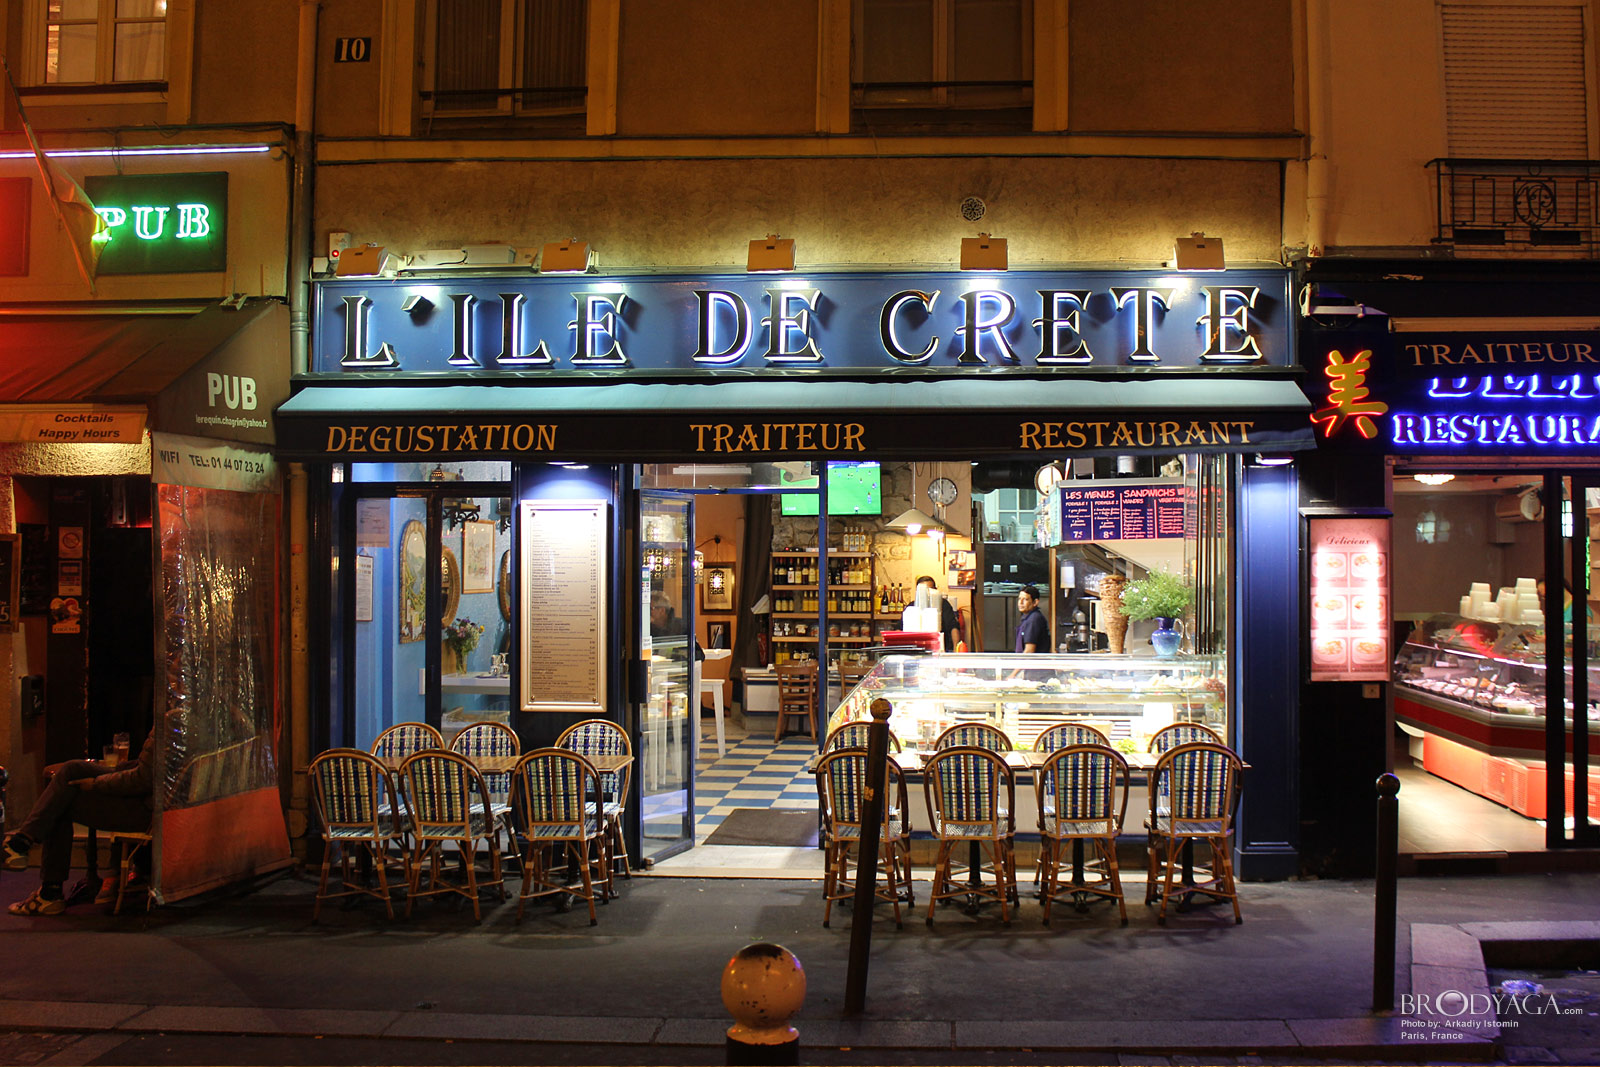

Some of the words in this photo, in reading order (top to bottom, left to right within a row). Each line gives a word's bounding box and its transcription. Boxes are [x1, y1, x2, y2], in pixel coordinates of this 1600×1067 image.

[340, 38, 366, 61] 10
[93, 203, 210, 240] PUB
[340, 292, 633, 368] L'ILE
[691, 289, 826, 365] DE
[879, 286, 1264, 364] CRETE
[1405, 343, 1600, 366] TRAITEUR
[207, 372, 258, 411] PUB
[1309, 349, 1390, 439] 美
[54, 413, 115, 423] Cocktails
[38, 429, 80, 440] Happy
[82, 429, 121, 438] Hours
[325, 424, 559, 453] DEGUSTATION
[689, 422, 867, 453] TRAITEUR
[1019, 421, 1255, 450] RESTAURANT
[160, 450, 180, 464] WIFI
[188, 454, 210, 467] TEL:
[211, 457, 222, 469] 01
[223, 458, 233, 470] 44
[234, 459, 243, 471] 07
[255, 462, 265, 474] 24
[1065, 491, 1082, 499] LES
[1084, 490, 1115, 499] MENUS
[1123, 488, 1176, 498] SANDWICHS
